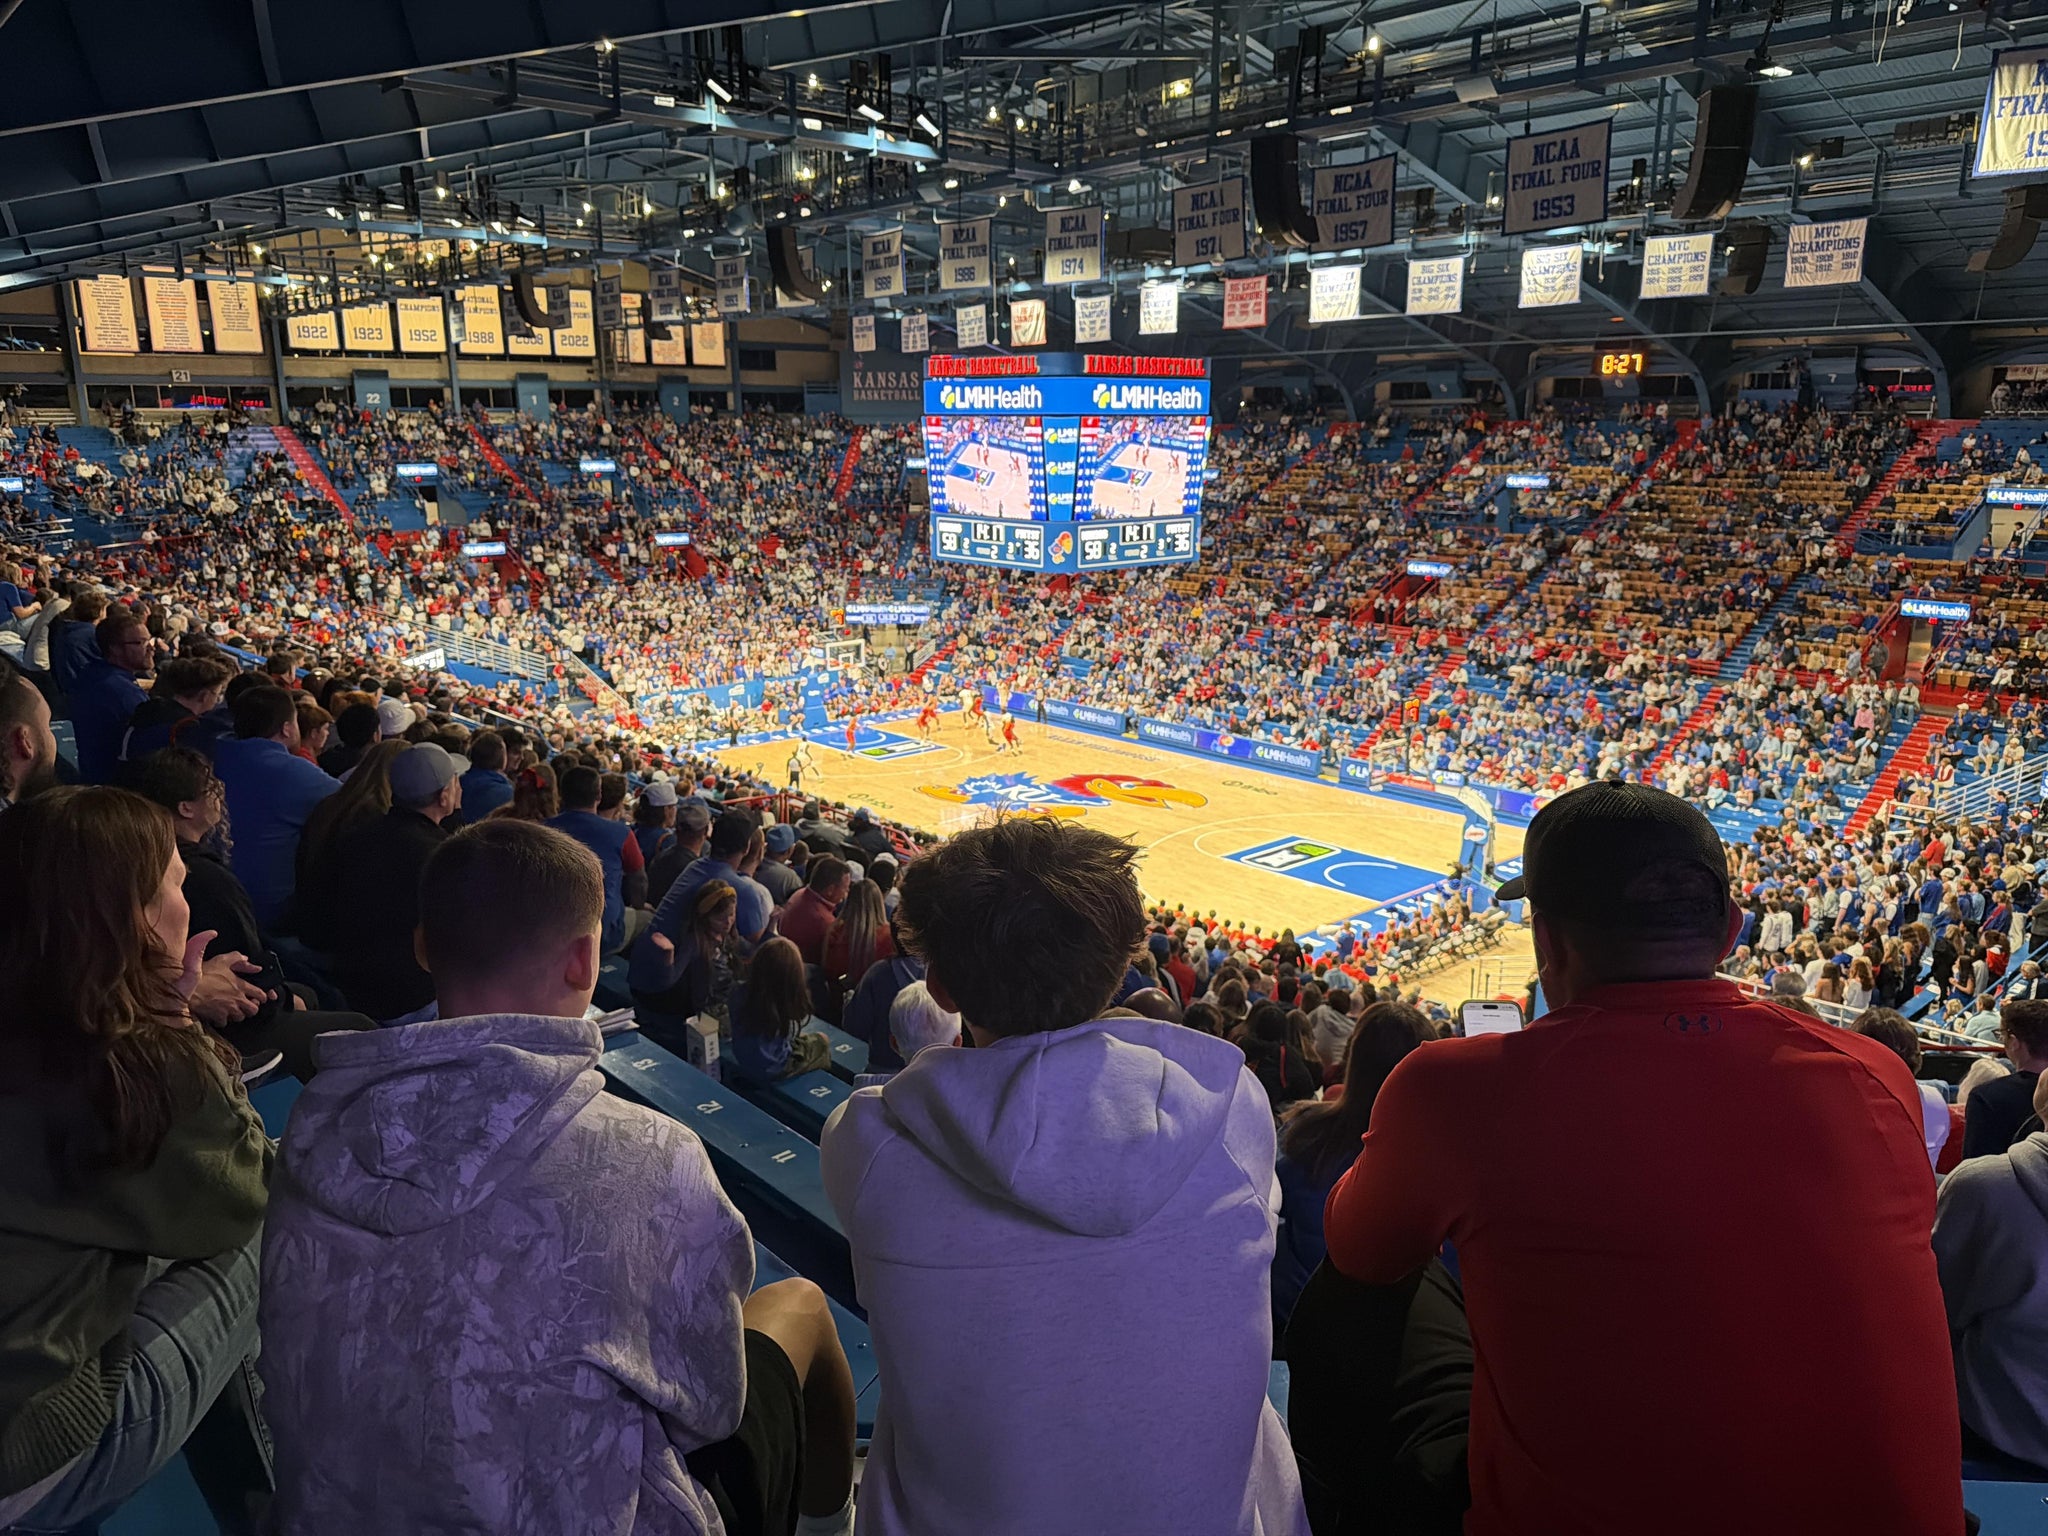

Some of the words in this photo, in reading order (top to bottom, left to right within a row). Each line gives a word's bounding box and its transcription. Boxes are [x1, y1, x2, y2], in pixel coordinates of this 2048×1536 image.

[1996, 91, 2048, 118] FINA
[1532, 137, 1581, 165] NCAA
[1333, 170, 1372, 193] NCAA
[1511, 170, 1555, 191] FINAL
[1561, 160, 1602, 184] FOUR
[1316, 195, 1352, 215] FINAL
[1356, 189, 1389, 211] FOUR
[1532, 194, 1576, 221] 1953
[1060, 214, 1087, 233] NCAA
[1178, 212, 1208, 233] FINAL
[1212, 208, 1240, 226] FOUR
[953, 227, 976, 244] NCAA
[1333, 220, 1368, 243] 1957
[1815, 225, 1841, 238] MVC
[1048, 236, 1074, 252] FINAL
[1076, 233, 1098, 249] FOUR
[1667, 240, 1690, 252] MVC
[1792, 237, 1860, 254] CHAMPIONS
[943, 247, 965, 260] FINAL
[1648, 251, 1707, 266] CHAMPIONS
[1062, 257, 1084, 275] 1974
[1411, 273, 1457, 286] CHAMPIONS
[400, 302, 440, 312] CHAMPIONS
[297, 325, 328, 339] 1922
[353, 326, 383, 340] 1923
[409, 329, 438, 342] 1952
[468, 331, 495, 344] 1988
[561, 334, 589, 347] 2022
[928, 357, 967, 376] KANSAS
[970, 355, 1038, 376] BASKETBALL
[1085, 355, 1132, 375] KANSAS
[1136, 357, 1205, 377] BASKETBALL
[1602, 353, 1643, 375] 8:27
[175, 370, 189, 382] 21
[853, 372, 920, 389] KANSAS
[1828, 373, 1836, 383] 7
[366, 392, 381, 404] 22
[1024, 541, 1040, 560] 36
[1174, 534, 1190, 552] 36
[809, 1085, 832, 1098] 12
[697, 1100, 723, 1115] 12
[771, 1150, 797, 1164] 11
